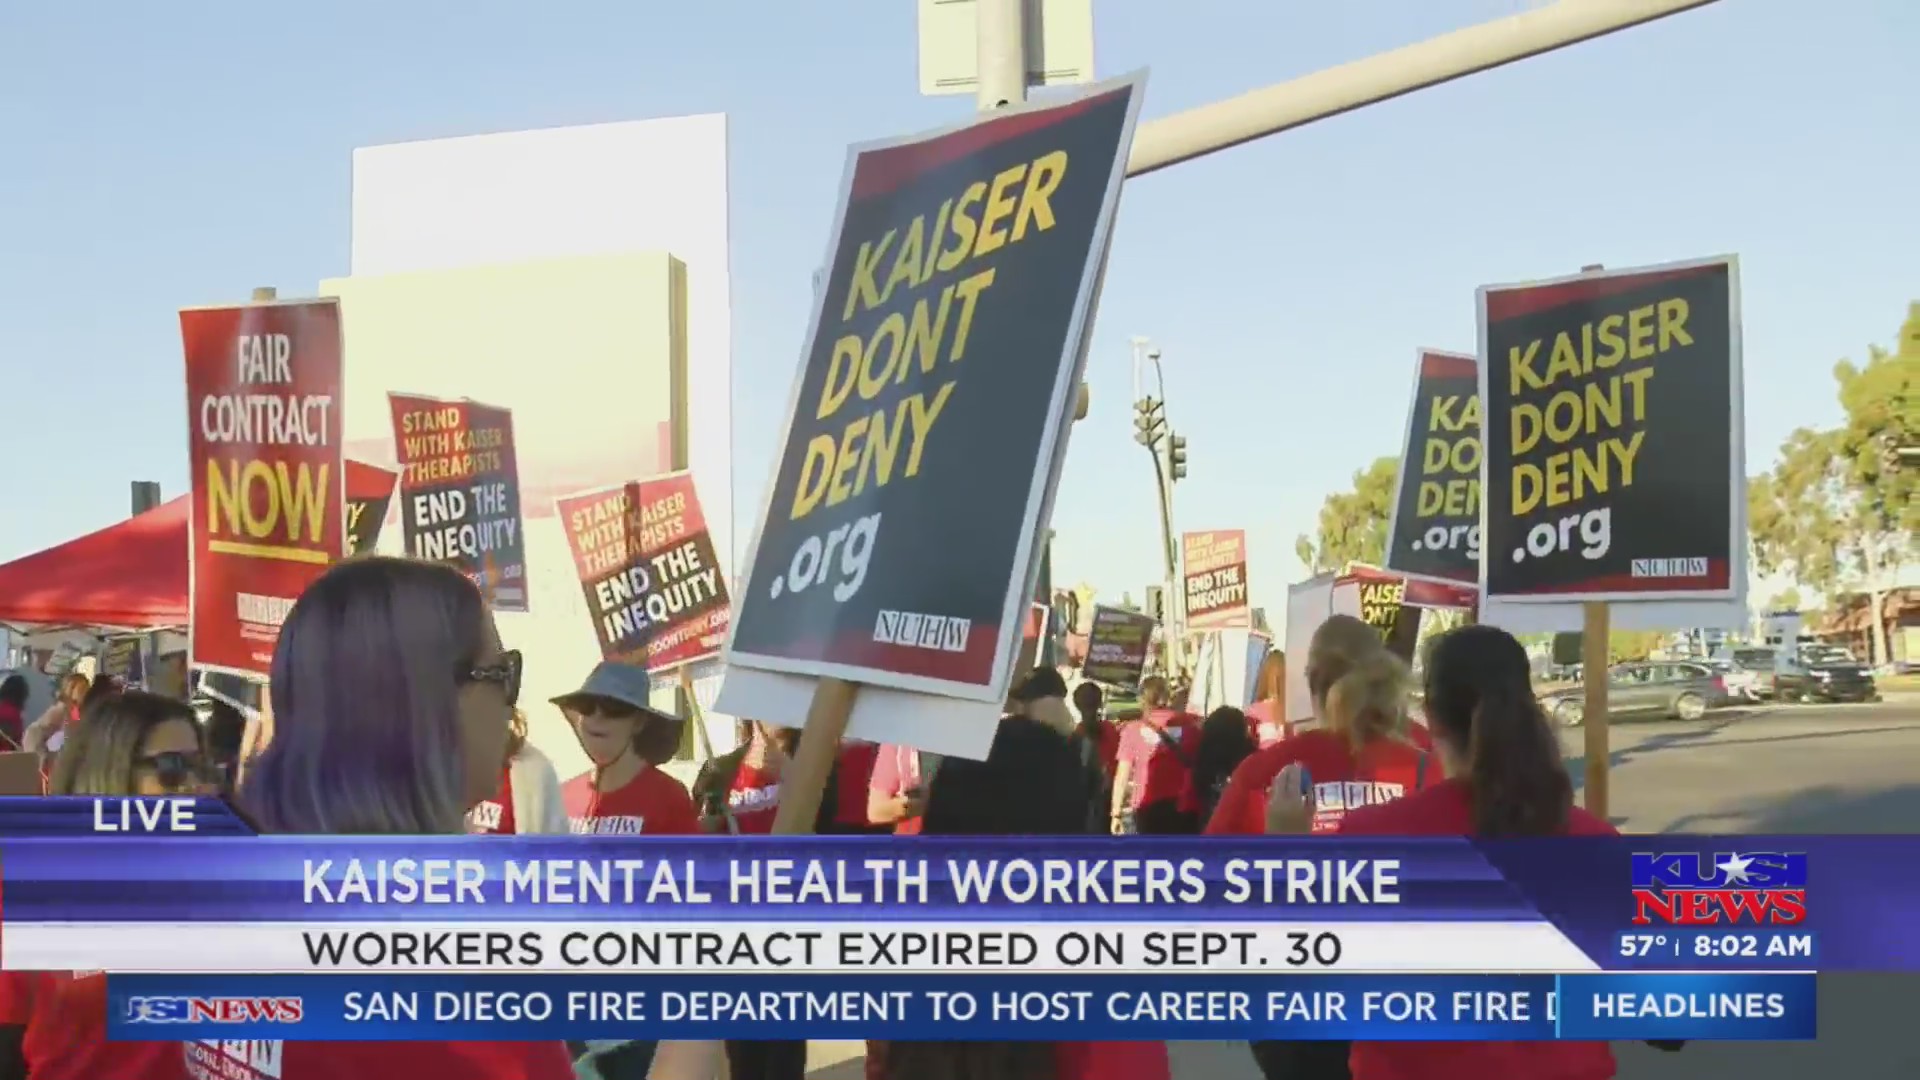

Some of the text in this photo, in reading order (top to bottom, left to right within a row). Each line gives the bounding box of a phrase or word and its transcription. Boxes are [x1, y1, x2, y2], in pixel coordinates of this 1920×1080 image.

[843, 150, 1068, 320] KAISER
[237, 334, 292, 383] FAIR
[817, 268, 995, 420] DONT
[1509, 298, 1694, 396] KAISER
[201, 394, 332, 446] CONTRACT
[402, 407, 460, 434] STAND
[1429, 395, 1481, 431] KA
[1511, 367, 1653, 456] DONT
[404, 427, 502, 459] WITH KAISER
[790, 381, 957, 520] DENY
[1423, 436, 1482, 475] DO
[406, 451, 501, 483] THERAPISTS
[1512, 431, 1645, 515] DENY
[207, 458, 330, 542] NOW
[414, 483, 506, 527] END THE
[572, 494, 631, 533] STAND
[415, 518, 516, 561] INEQUITY
[578, 515, 625, 553] WITH
[1512, 507, 1611, 563] .org
[595, 542, 701, 611] END THE
[770, 512, 882, 603] .org
[1187, 566, 1239, 595] END THE
[603, 568, 719, 642] INEQUITY
[1187, 583, 1245, 613] INEQUITY
[1361, 583, 1402, 604] AISE
[874, 609, 971, 652] NUHW
